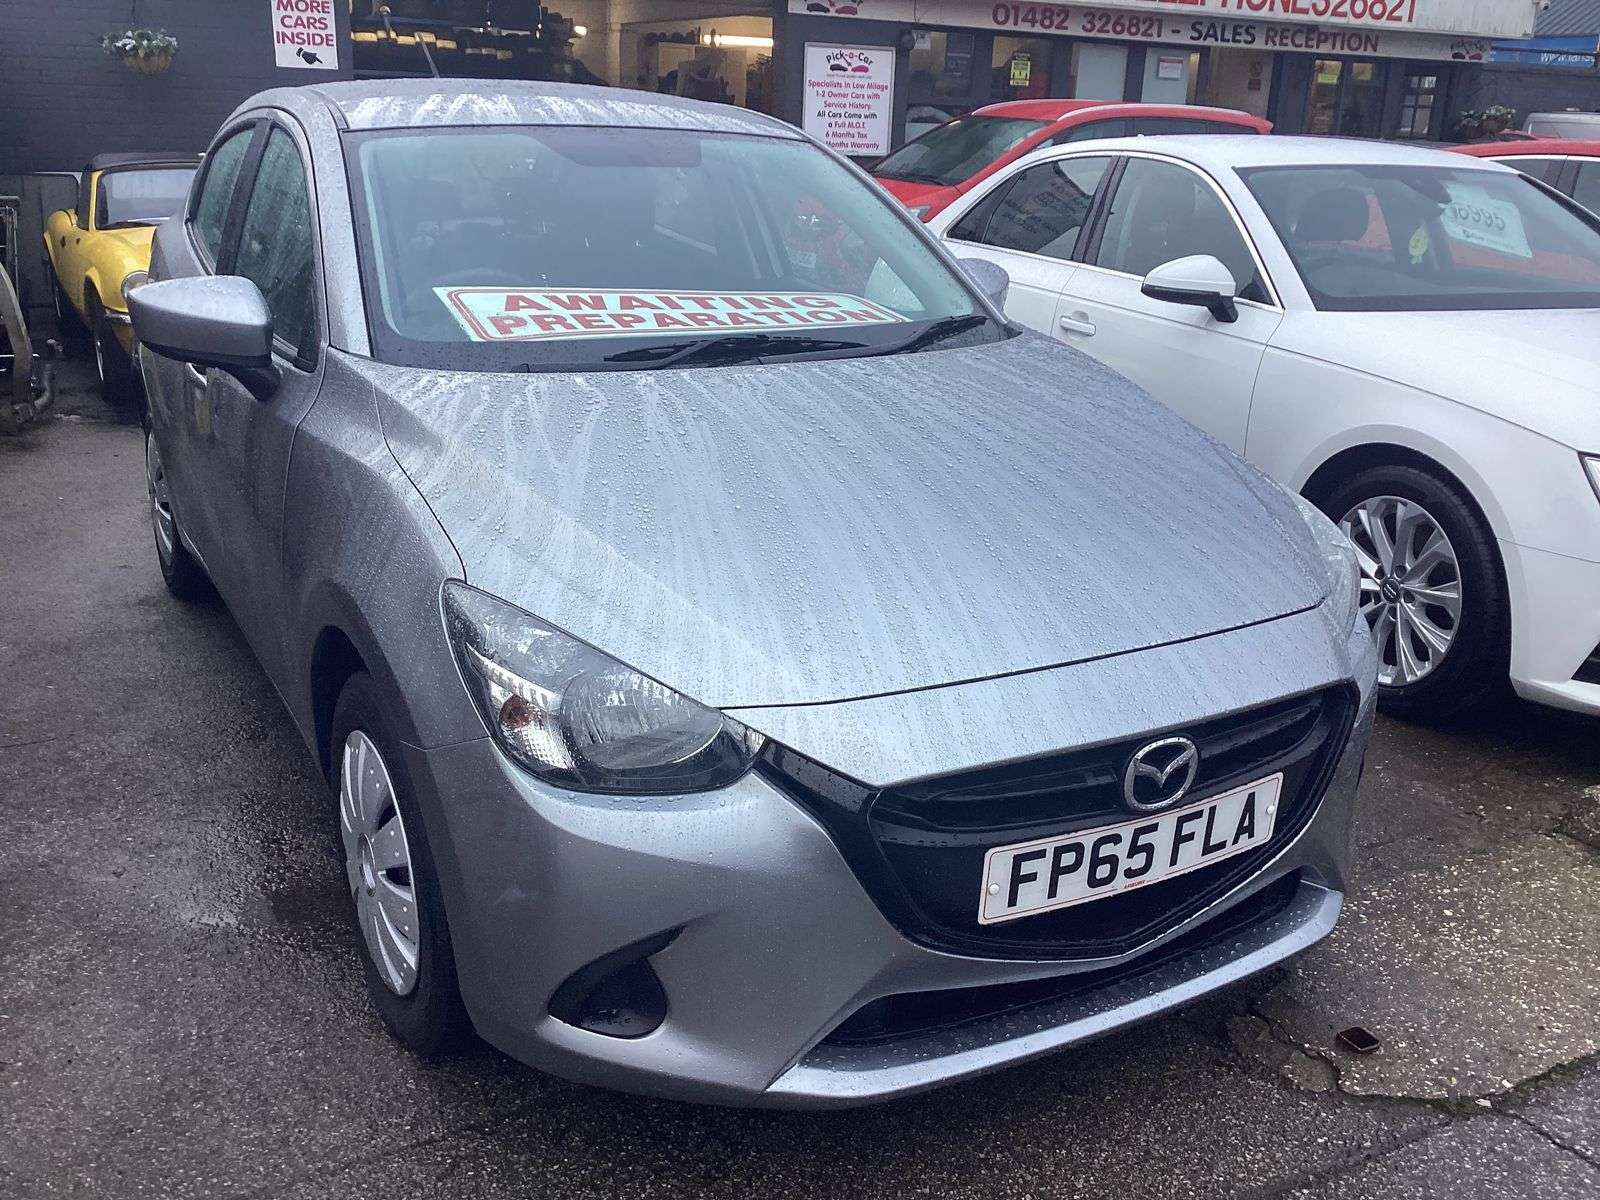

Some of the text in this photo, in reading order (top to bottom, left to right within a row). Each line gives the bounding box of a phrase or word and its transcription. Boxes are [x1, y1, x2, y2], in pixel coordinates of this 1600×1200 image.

[276, 0, 331, 14] MORE
[280, 15, 328, 30] CARS
[992, 4, 1070, 31] 01482
[1081, 11, 1163, 38] 326821
[1189, 21, 1256, 44] SALES
[1264, 26, 1380, 52] RECEPTION
[276, 31, 334, 47] INSIDE
[808, 80, 843, 89] Specialists
[853, 81, 865, 89] Low
[866, 82, 889, 92] Milage
[816, 90, 826, 98] 1-2
[851, 91, 865, 99] Cars
[867, 92, 881, 100] with
[824, 101, 847, 109] Service
[827, 111, 842, 119] Cars
[844, 111, 862, 119] Come
[864, 112, 878, 120] with
[831, 131, 855, 139] Months
[850, 142, 880, 150] Warranty
[504, 294, 840, 312] AWAITING
[487, 309, 886, 335] PREPARATION
[1007, 791, 1256, 909] FP65 FLA
